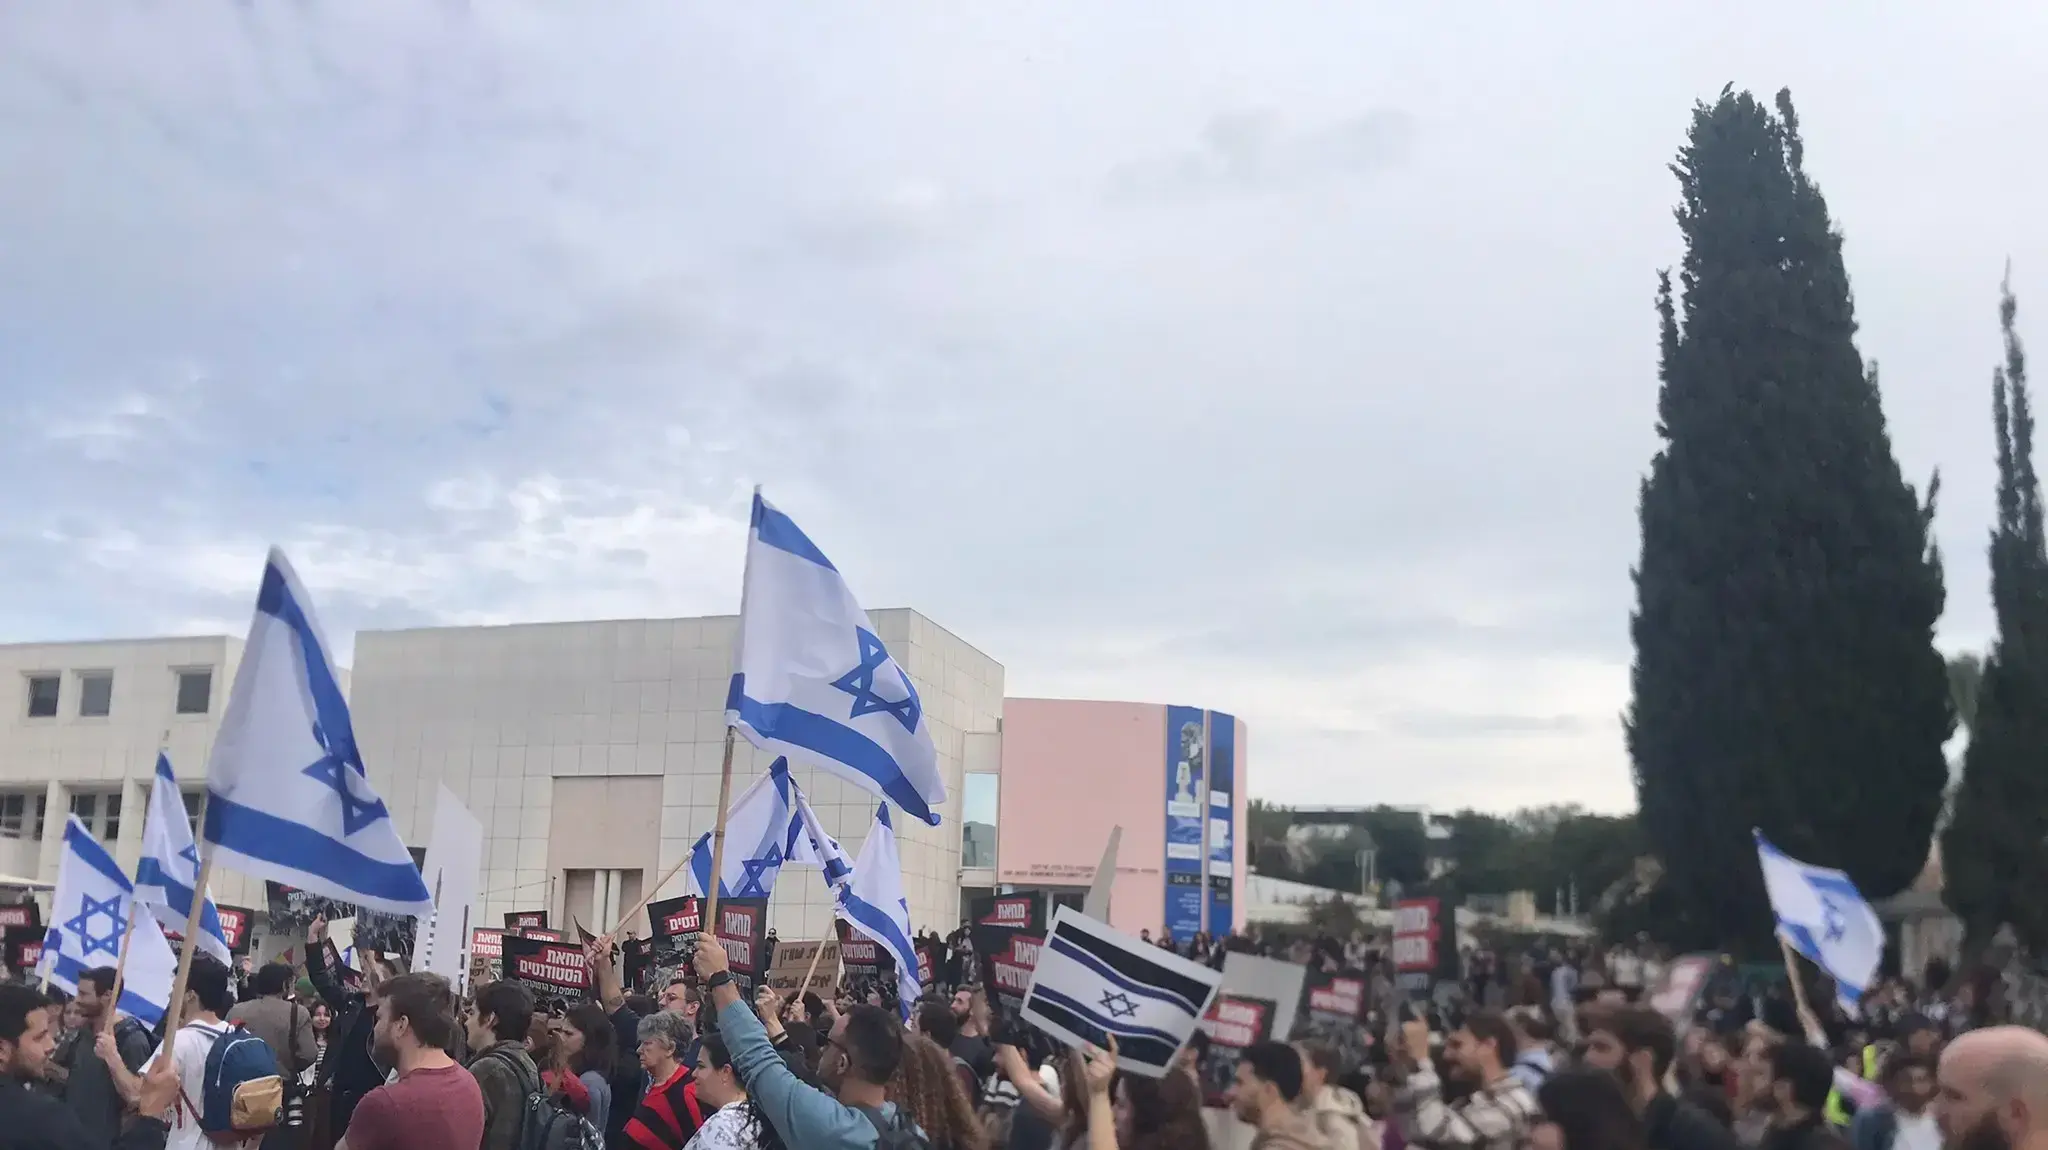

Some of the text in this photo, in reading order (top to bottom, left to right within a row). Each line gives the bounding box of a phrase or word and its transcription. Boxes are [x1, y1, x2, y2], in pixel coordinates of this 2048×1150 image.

[998, 904, 1025, 919] מחאת
[519, 917, 539, 926] מחאת
[725, 912, 751, 937] מחאת
[546, 949, 585, 968] מחאת
[519, 959, 583, 984] הסטודנטים
[549, 984, 558, 994] על
[558, 986, 582, 997] נלחמים
